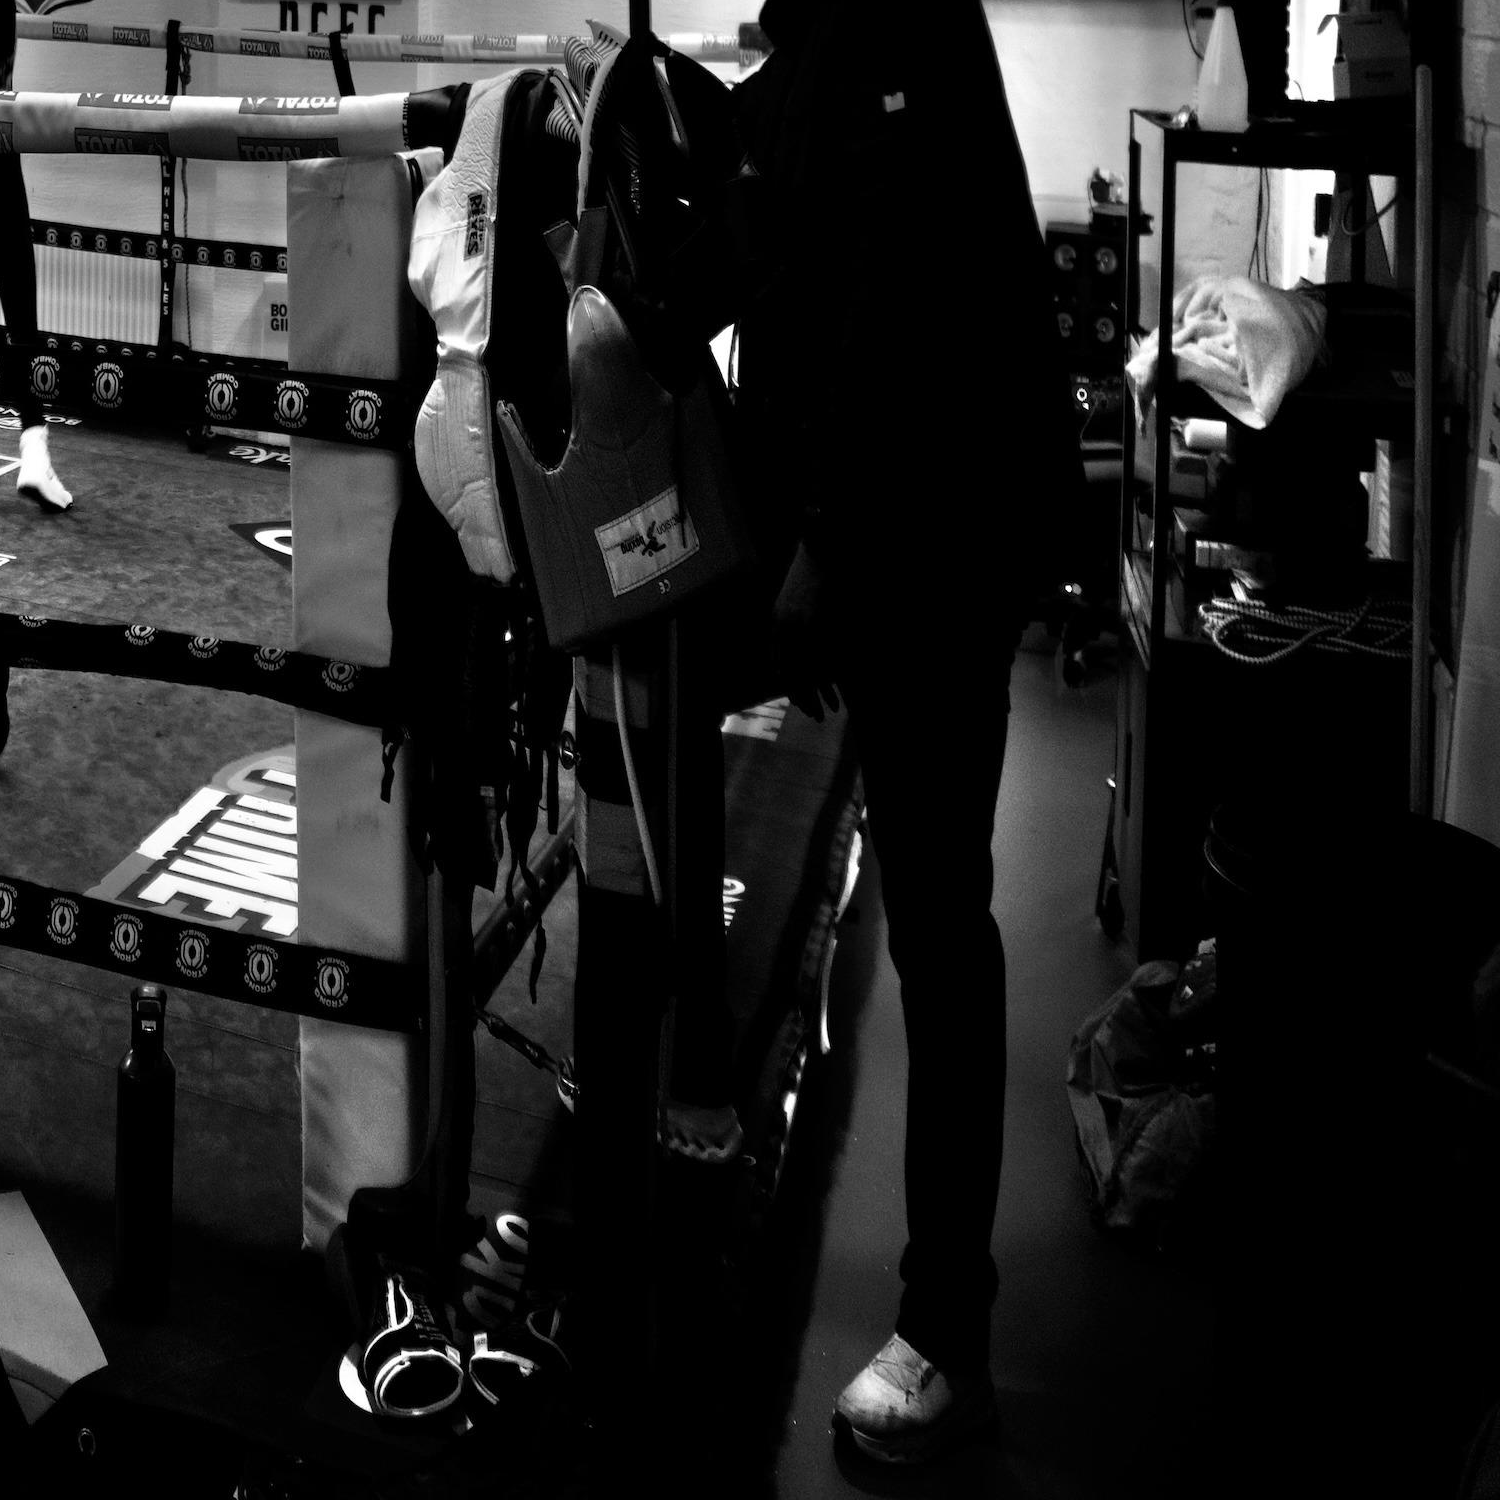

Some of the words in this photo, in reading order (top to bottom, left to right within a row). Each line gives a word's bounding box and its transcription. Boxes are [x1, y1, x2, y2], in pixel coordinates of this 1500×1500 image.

[54, 22, 78, 35] TOTAL
[114, 27, 140, 40] TOTAL
[241, 40, 269, 53] TOTAL
[308, 48, 331, 60] TOTA
[30, 355, 60, 372] COMBAT
[94, 362, 123, 379] COMBAT
[207, 372, 239, 389] COMBAT
[276, 380, 309, 397] COMBAT
[348, 389, 382, 407] COMBAT
[620, 535, 646, 555] boxing
[113, 912, 143, 931] COMBAT
[46, 924, 77, 945] STRONG
[178, 928, 210, 947] COMBAT
[109, 941, 141, 963] STRONG
[246, 943, 279, 961] COMBAT
[175, 958, 208, 979] STRONG
[316, 956, 350, 975] COMBAT
[244, 972, 277, 994] STRONG
[314, 988, 349, 1009] STRONG
